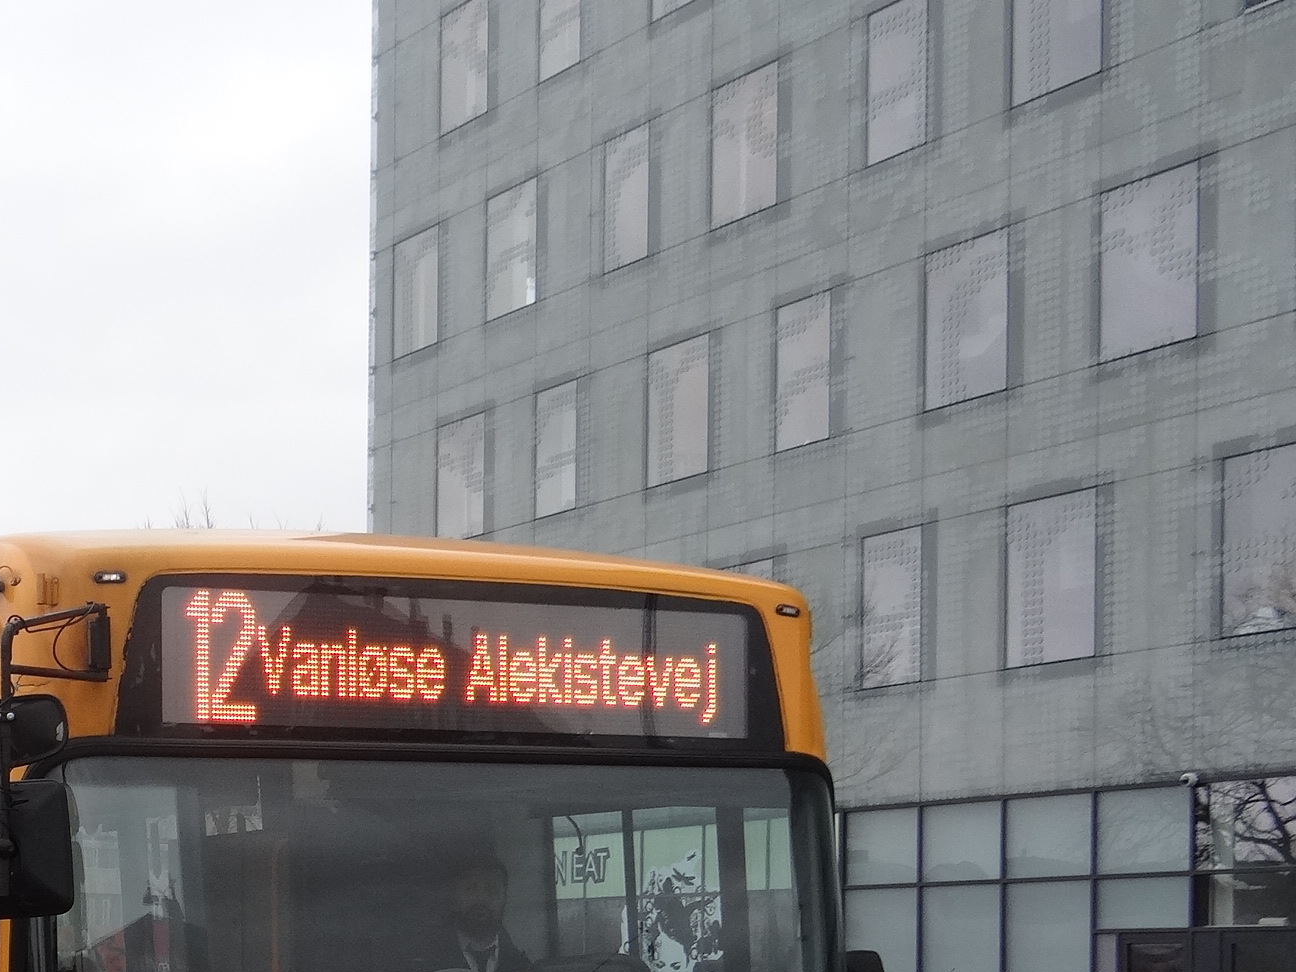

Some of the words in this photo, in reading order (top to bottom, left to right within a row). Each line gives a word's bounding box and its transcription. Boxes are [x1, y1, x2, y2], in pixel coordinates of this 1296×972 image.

[185, 590, 257, 721] 12
[257, 624, 446, 701] Vanløse
[465, 632, 718, 726] Alekistevej
